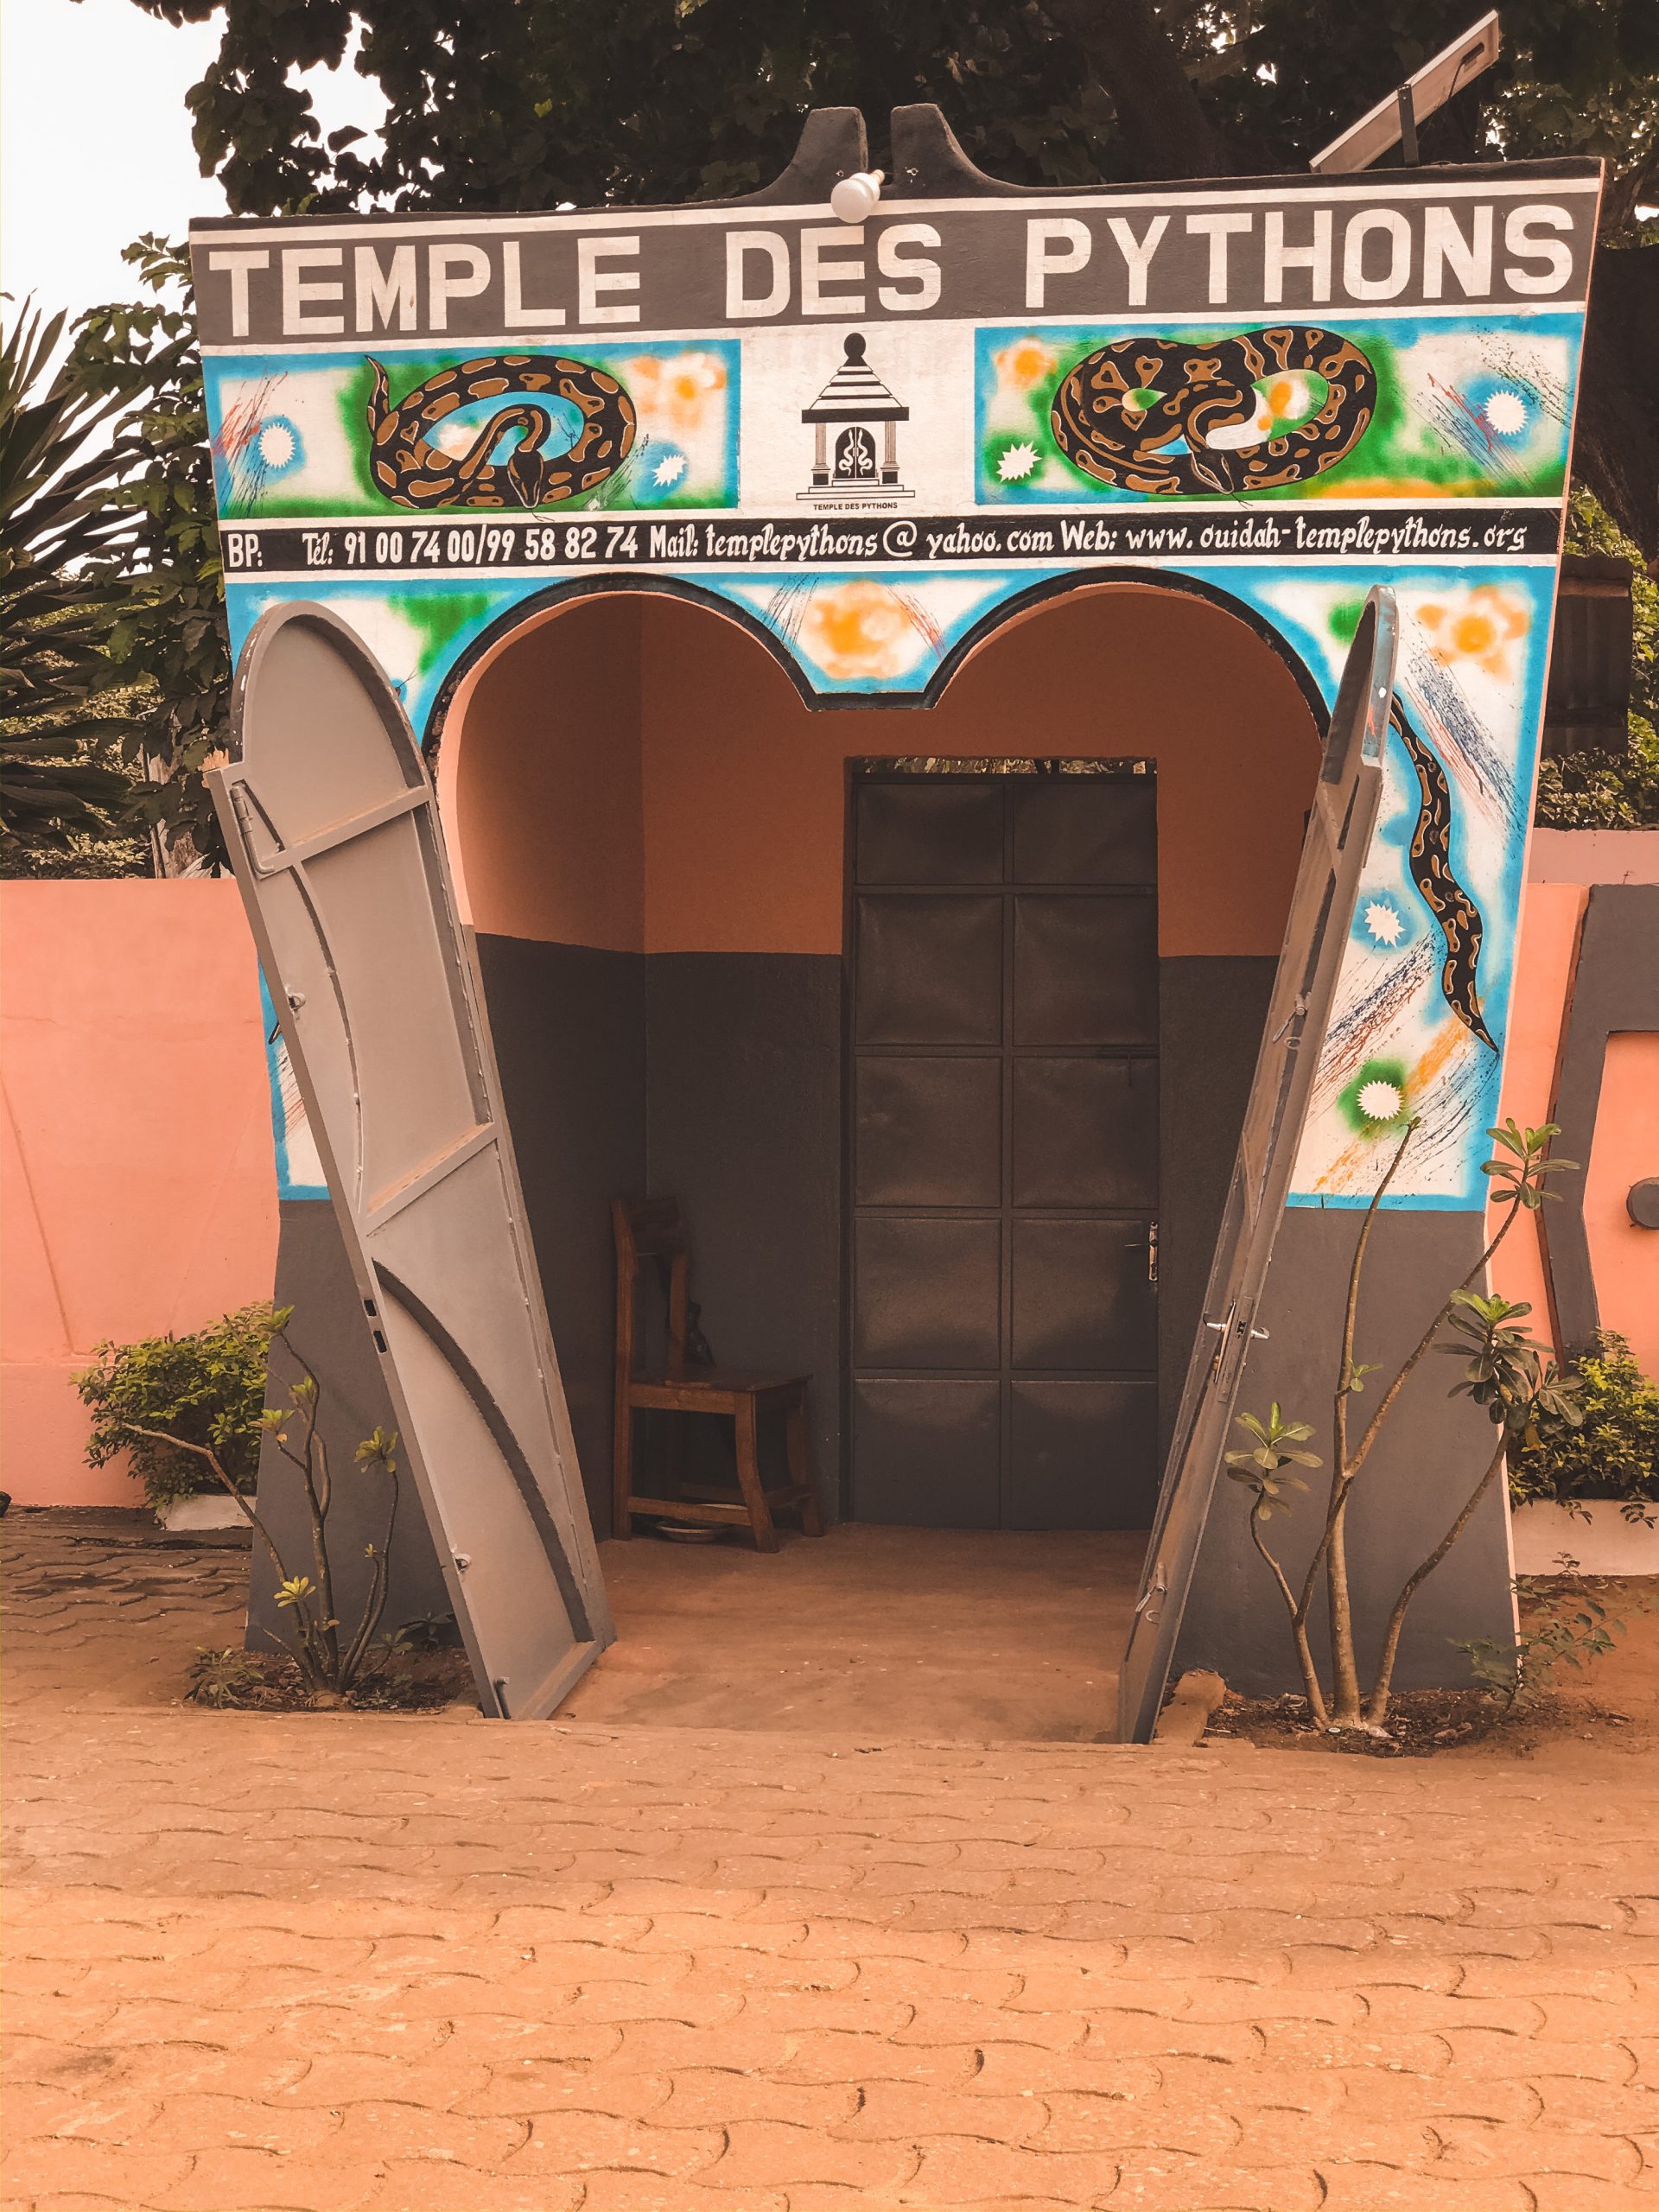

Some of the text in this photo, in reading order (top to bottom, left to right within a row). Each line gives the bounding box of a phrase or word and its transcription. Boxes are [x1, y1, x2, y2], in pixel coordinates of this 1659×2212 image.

[208, 207, 1575, 337] TEMPLE DES PYTHONS
[227, 533, 264, 568] BP:
[302, 531, 334, 566] Tél:
[345, 531, 366, 564] 91
[375, 531, 404, 563] 00
[410, 531, 441, 563] 74
[524, 528, 556, 561] 58
[564, 526, 598, 559] 82
[605, 525, 639, 558] 74
[649, 523, 699, 558] Mail:
[1060, 519, 1118, 551] Web:
